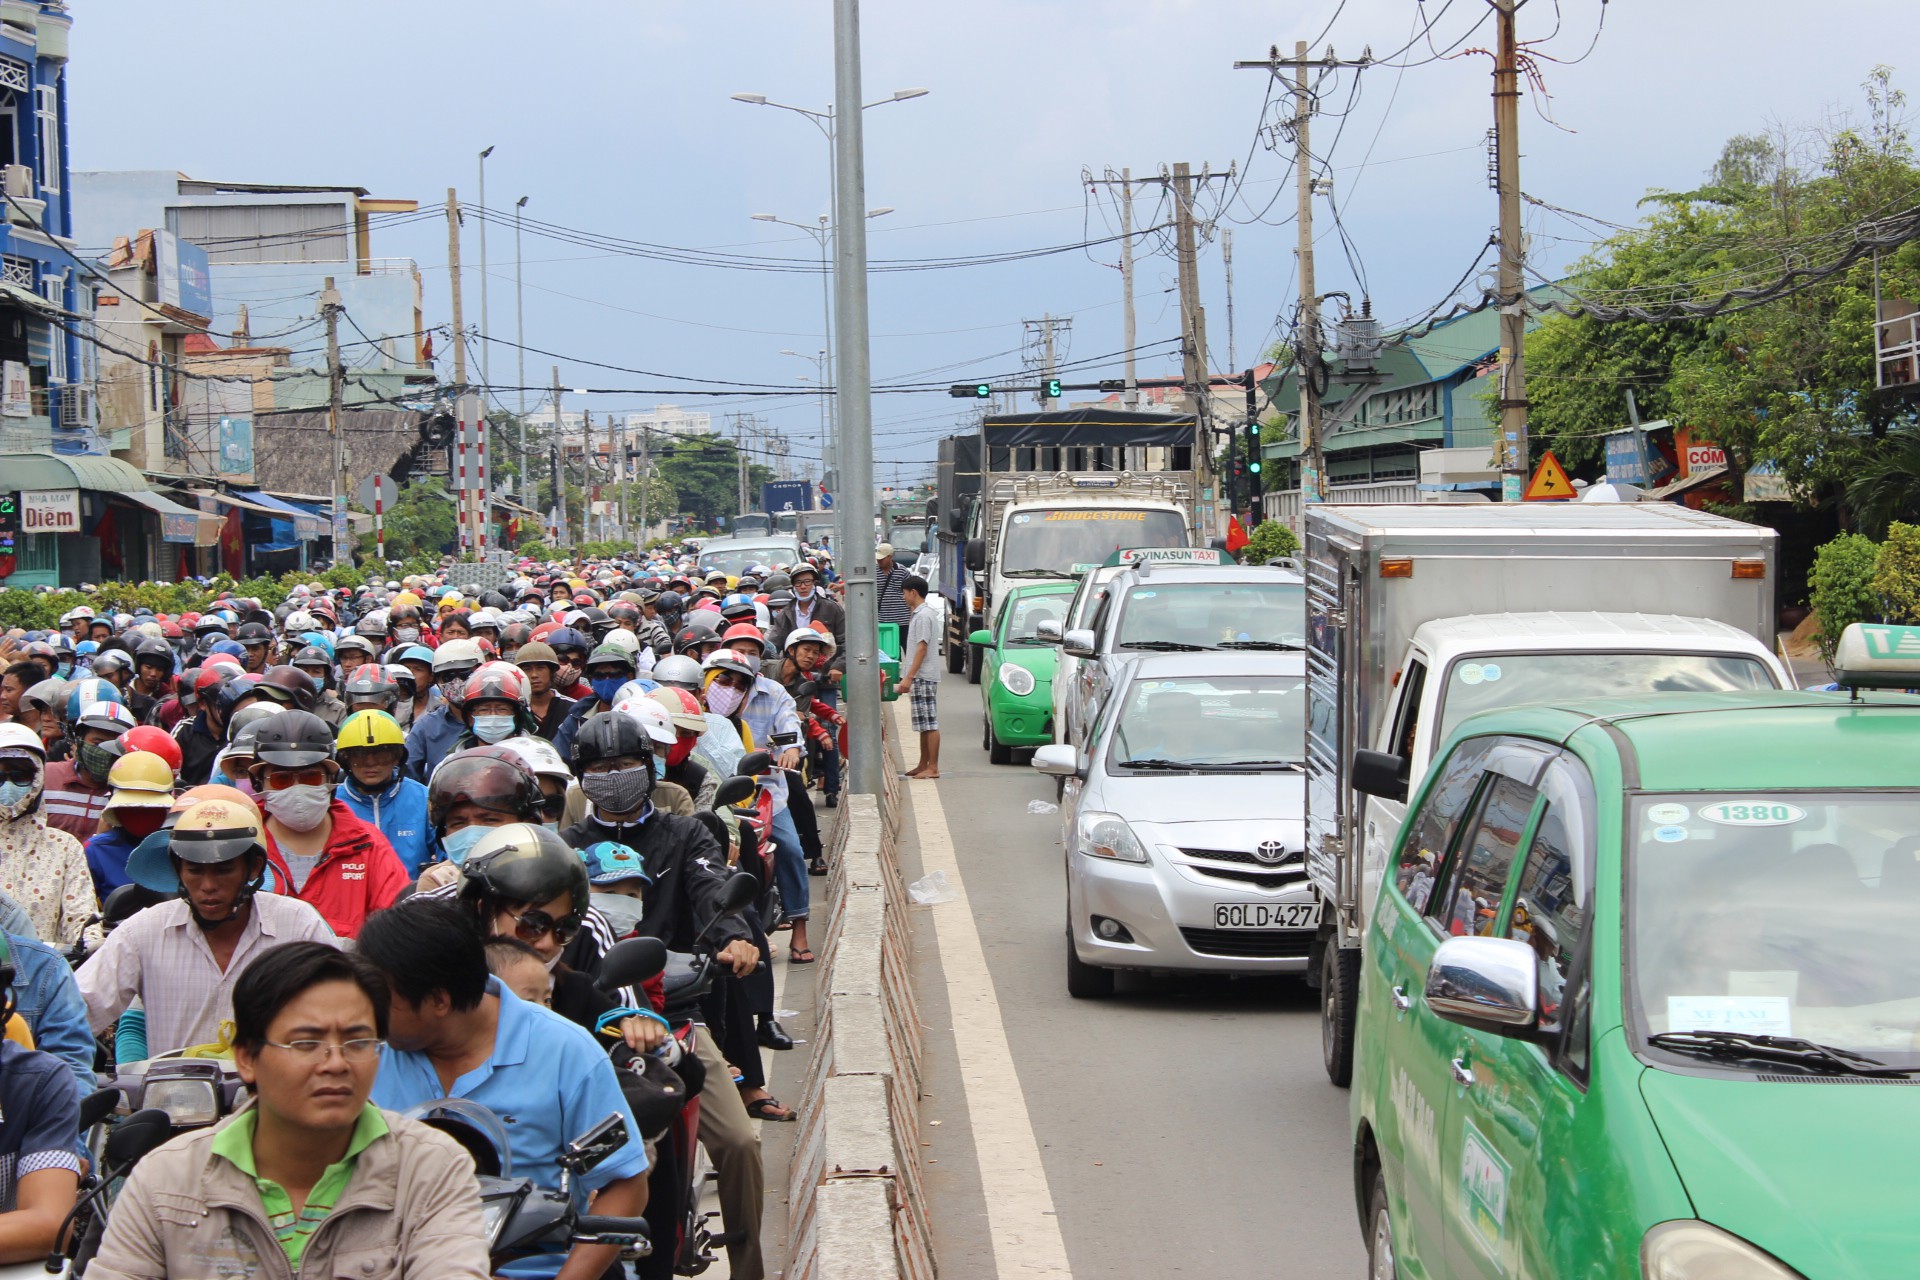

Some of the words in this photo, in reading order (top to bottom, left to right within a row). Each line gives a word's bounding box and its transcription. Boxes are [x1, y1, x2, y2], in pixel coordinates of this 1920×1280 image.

[783, 501, 793, 511] 45
[1045, 511, 1147, 521] BRIDGESTONE
[1142, 550, 1192, 560] VINASUN
[1193, 550, 1216, 560] TAXI
[1717, 805, 1790, 821] 1380
[342, 872, 366, 880] SPORT
